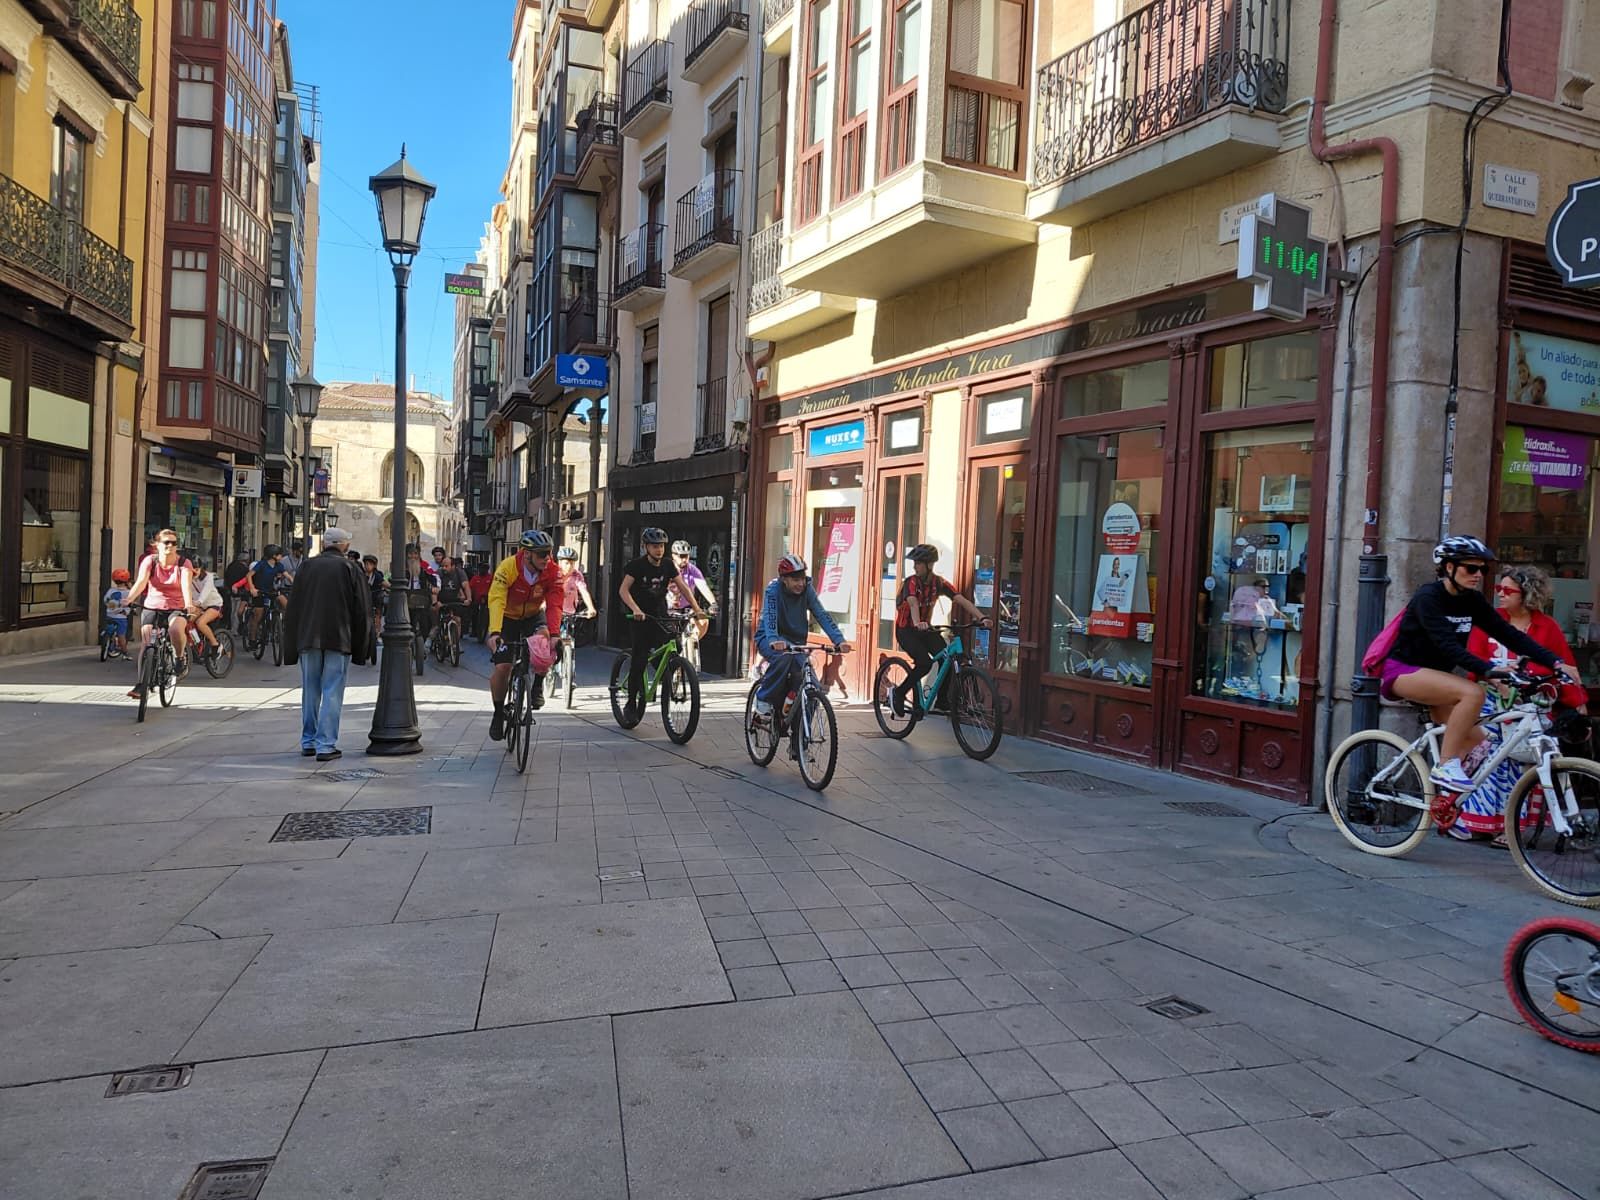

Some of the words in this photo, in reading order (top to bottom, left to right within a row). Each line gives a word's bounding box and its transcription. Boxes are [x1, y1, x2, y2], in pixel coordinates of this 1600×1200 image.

[1504, 174, 1527, 186] CALLE
[1508, 185, 1518, 195] DE
[1236, 201, 1260, 215] CALLE
[1262, 236, 1319, 280] 11:04
[1581, 237, 1600, 263] P
[447, 285, 480, 295] BOLSOS
[1081, 302, 1206, 347] Farmacia
[1540, 346, 1554, 361] Un
[1555, 351, 1582, 367] aliado
[893, 366, 960, 393] Yolanda
[967, 351, 1013, 376] Vara
[1560, 368, 1574, 383] de
[1574, 371, 1595, 386] toda
[559, 375, 604, 387] Samsonite
[798, 389, 850, 414] Farmacia
[825, 431, 850, 444] NUXE
[1539, 461, 1571, 477] VITAMINA
[696, 496, 724, 511] WORLD
